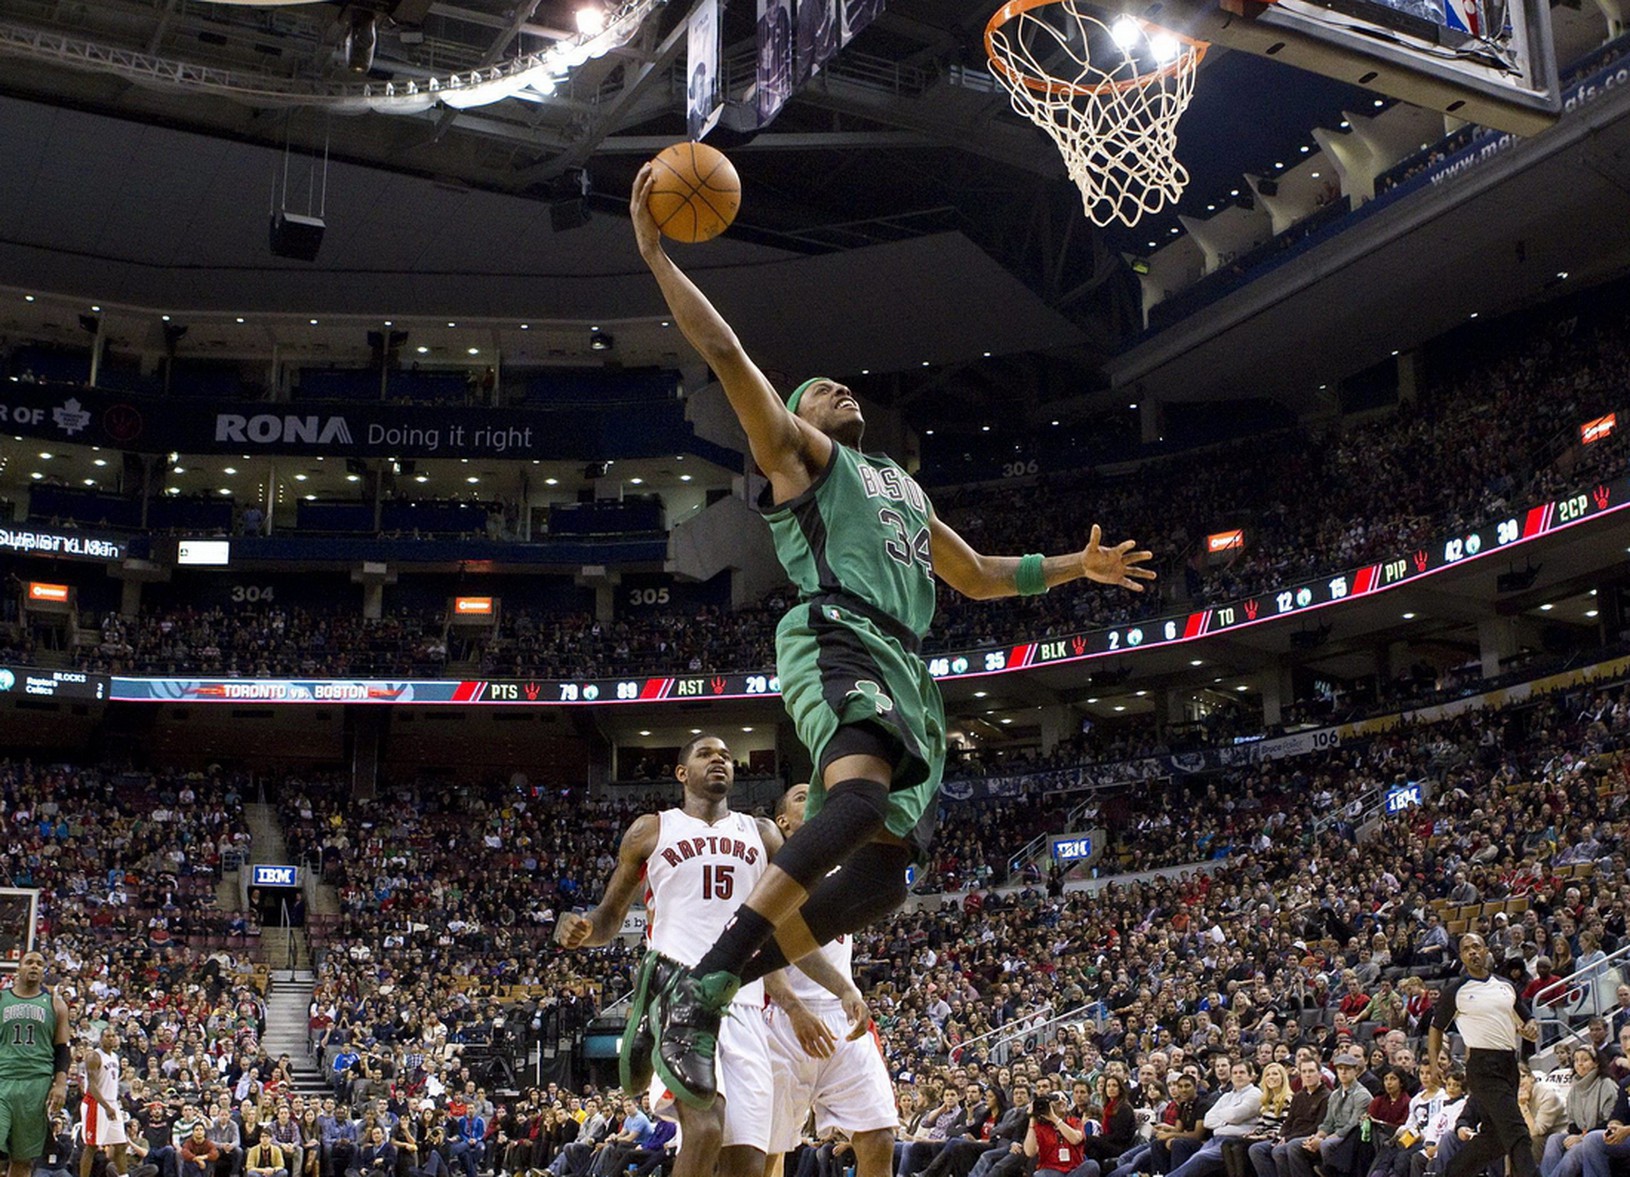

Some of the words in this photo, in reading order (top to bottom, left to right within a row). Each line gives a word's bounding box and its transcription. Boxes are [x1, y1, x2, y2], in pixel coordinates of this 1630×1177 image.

[13, 407, 45, 425] OF
[214, 414, 354, 443] RONA
[368, 424, 440, 450] Doing
[450, 425, 465, 447] it
[474, 425, 533, 452] right
[1002, 459, 1039, 478] 306
[1558, 494, 1588, 522] 2CP
[878, 508, 935, 583] 34
[1384, 559, 1408, 584] PIP
[232, 586, 275, 602] 304
[629, 587, 670, 605] 305
[1329, 576, 1348, 600] 15
[1276, 591, 1294, 613] 12
[1217, 607, 1235, 627] TO
[1164, 620, 1177, 640] 6
[1041, 640, 1067, 661] BLK
[1108, 631, 1120, 650] 2
[52, 672, 87, 684] BLOCKS
[677, 679, 705, 696] AST
[223, 683, 287, 699] TORONTO
[315, 684, 369, 700] BOSTON
[491, 684, 519, 700] PTS
[1313, 730, 1338, 747] 106
[660, 836, 759, 868] RAPTORS
[257, 867, 293, 884] IBM
[702, 864, 735, 900] 15
[11, 1023, 37, 1047] 11
